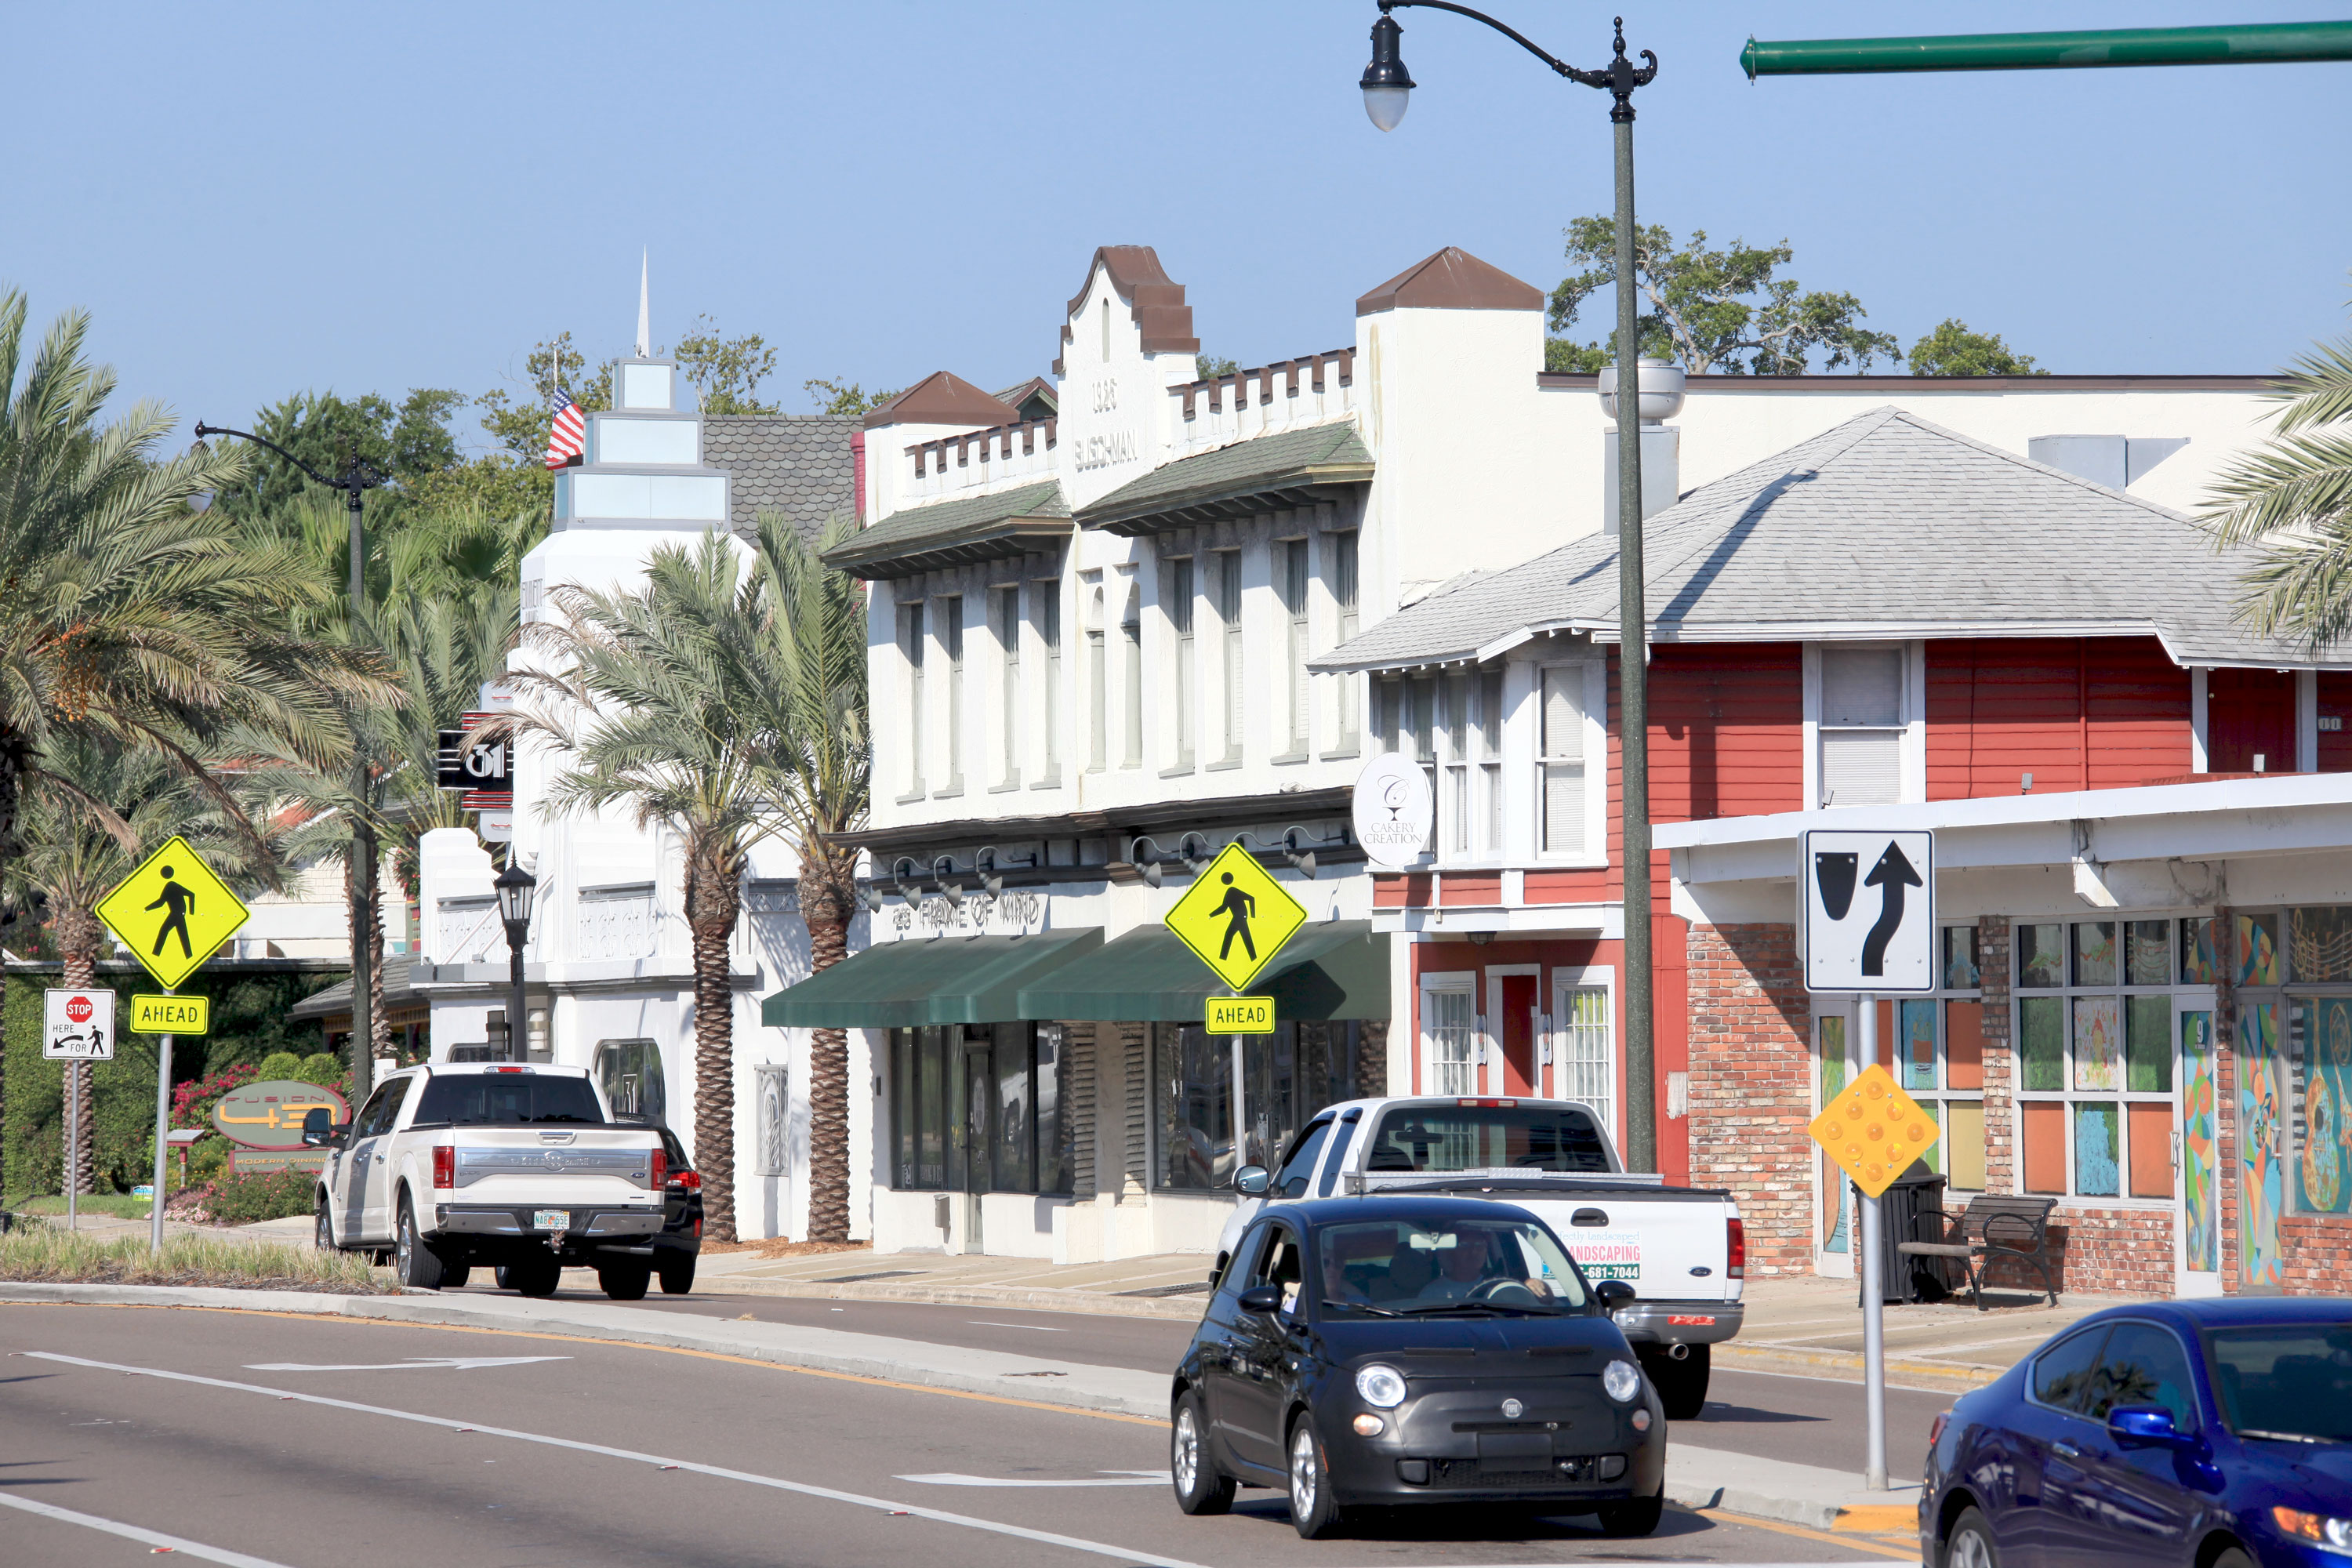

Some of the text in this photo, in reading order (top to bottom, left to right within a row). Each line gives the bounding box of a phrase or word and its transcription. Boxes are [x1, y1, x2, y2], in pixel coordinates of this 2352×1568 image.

[1074, 428, 1137, 473] BUSCHMAN
[1370, 822, 1417, 833] CAKERY
[1364, 833, 1422, 844] CREATION
[971, 894, 994, 925] OF
[999, 891, 1040, 924] MIND
[67, 1004, 92, 1015] STOP
[141, 1005, 198, 1023] AHEAD
[1215, 1007, 1265, 1023] AHEAD
[53, 1024, 74, 1033] HERE
[2197, 1019, 2204, 1044] 9
[70, 1044, 87, 1053] FOR
[225, 1095, 325, 1104] FUSION
